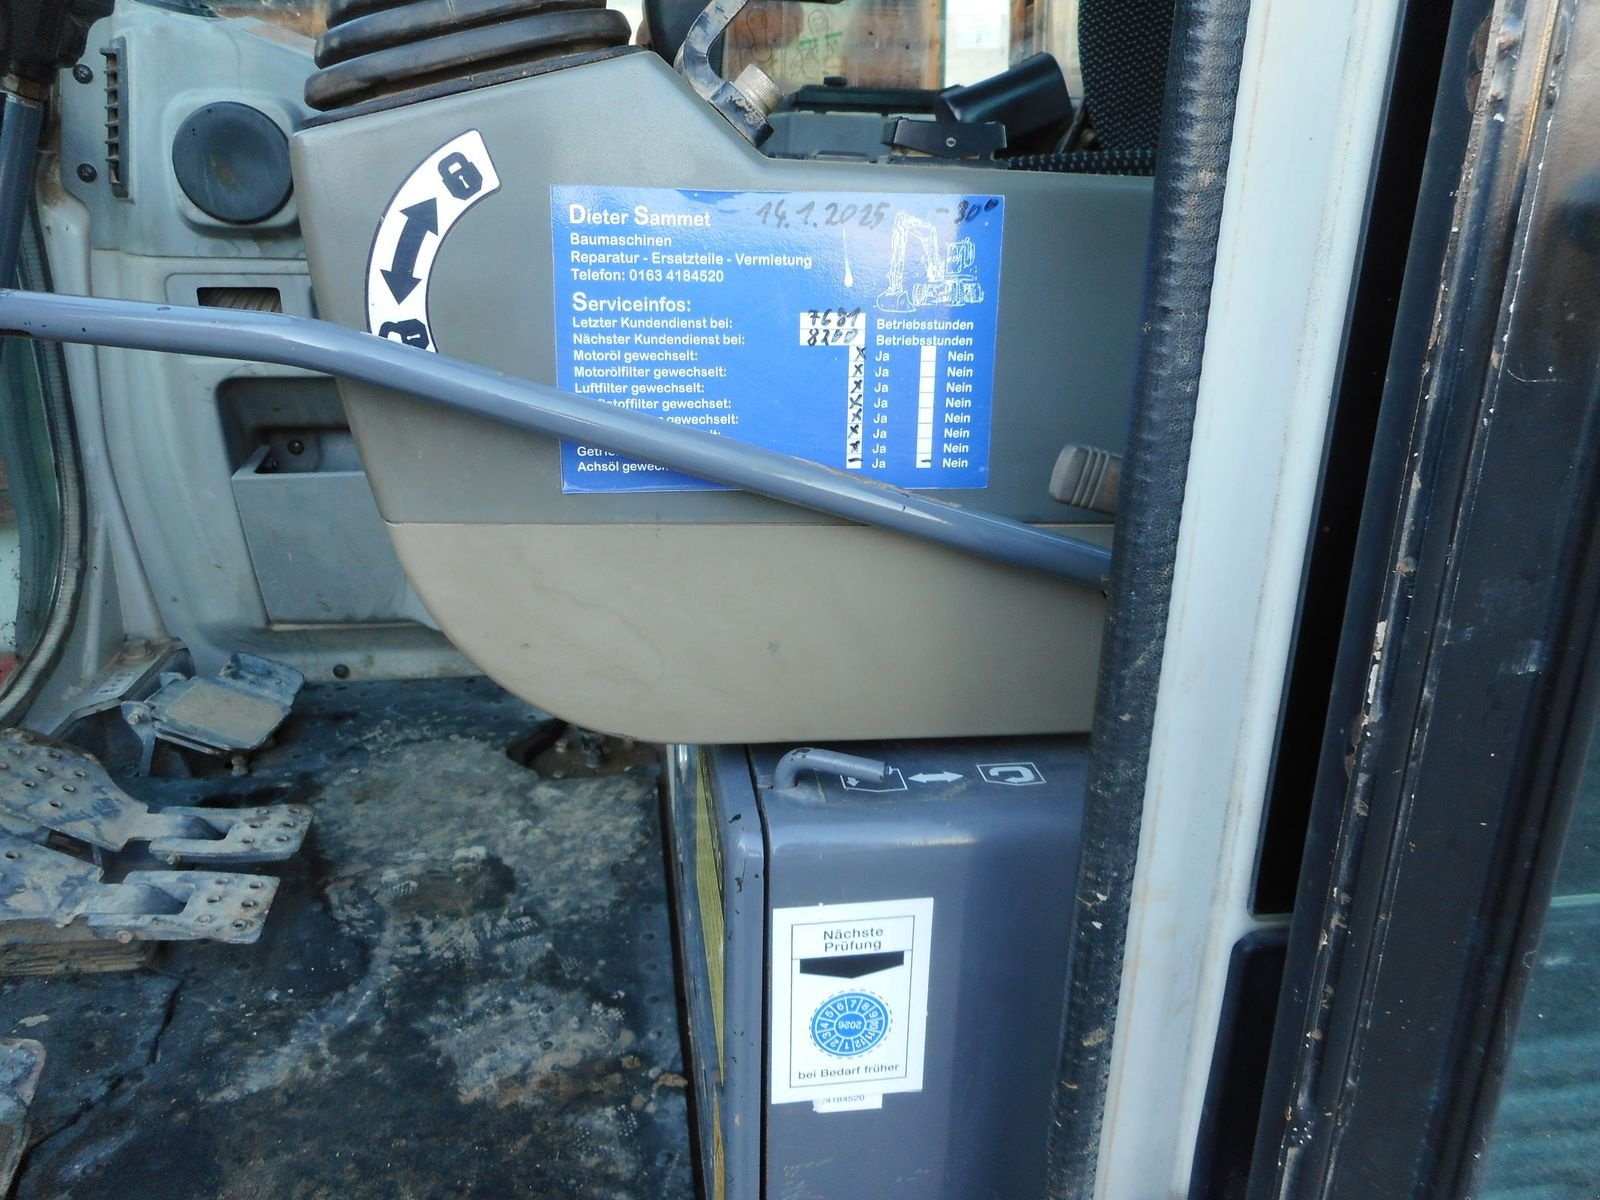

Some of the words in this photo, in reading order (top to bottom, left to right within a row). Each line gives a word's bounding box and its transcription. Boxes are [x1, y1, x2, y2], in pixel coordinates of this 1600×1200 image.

[568, 203, 629, 225] Dieter
[633, 205, 712, 227] Sammet
[569, 232, 672, 248] Baumaschinen
[570, 250, 641, 267] Reparatur
[651, 251, 724, 266] Ersatzteile
[734, 252, 813, 269] Vermietung
[570, 267, 626, 282] Telefon:
[628, 268, 663, 282] 0163
[665, 269, 725, 283] 4184520
[571, 291, 692, 313] Serviceinfos:
[572, 316, 618, 329] Letzter
[620, 316, 708, 330] Kundendienst
[709, 316, 733, 330] bei:
[876, 318, 975, 331] Betriebsstunden
[572, 332, 632, 345] Nächster
[633, 333, 721, 346] Kundendienst
[722, 333, 746, 346] bei:
[875, 334, 974, 347] Betriebsstunden
[573, 349, 621, 362] Motoröl
[623, 349, 698, 364] gewechselt:
[874, 350, 890, 362] Ja
[947, 350, 975, 362] Nein
[574, 365, 651, 378] Motorölfilter
[653, 366, 728, 380] gewechselt:
[874, 365, 890, 378] Ja
[946, 365, 974, 378] Nein
[574, 382, 629, 394] Luftfilter
[631, 382, 705, 396] gewechselt:
[873, 381, 889, 394] Ja
[945, 381, 973, 393] Nein
[662, 398, 732, 412] gewechset:
[873, 396, 889, 409] Ja
[945, 396, 972, 409] Nein
[872, 412, 888, 424] Ja
[944, 412, 972, 424] Nein
[872, 427, 888, 440] Ja
[943, 427, 971, 439] Nein
[871, 442, 887, 455] Ja
[942, 442, 970, 454] Nein
[577, 461, 620, 472] Achsöl
[871, 457, 887, 469] Ja
[941, 457, 969, 469] Nein
[822, 928, 884, 941] Nächste
[824, 940, 882, 953] Prüfung
[798, 1070, 816, 1080] bei
[820, 1066, 861, 1078] Bedarf
[863, 1063, 900, 1075] früher
